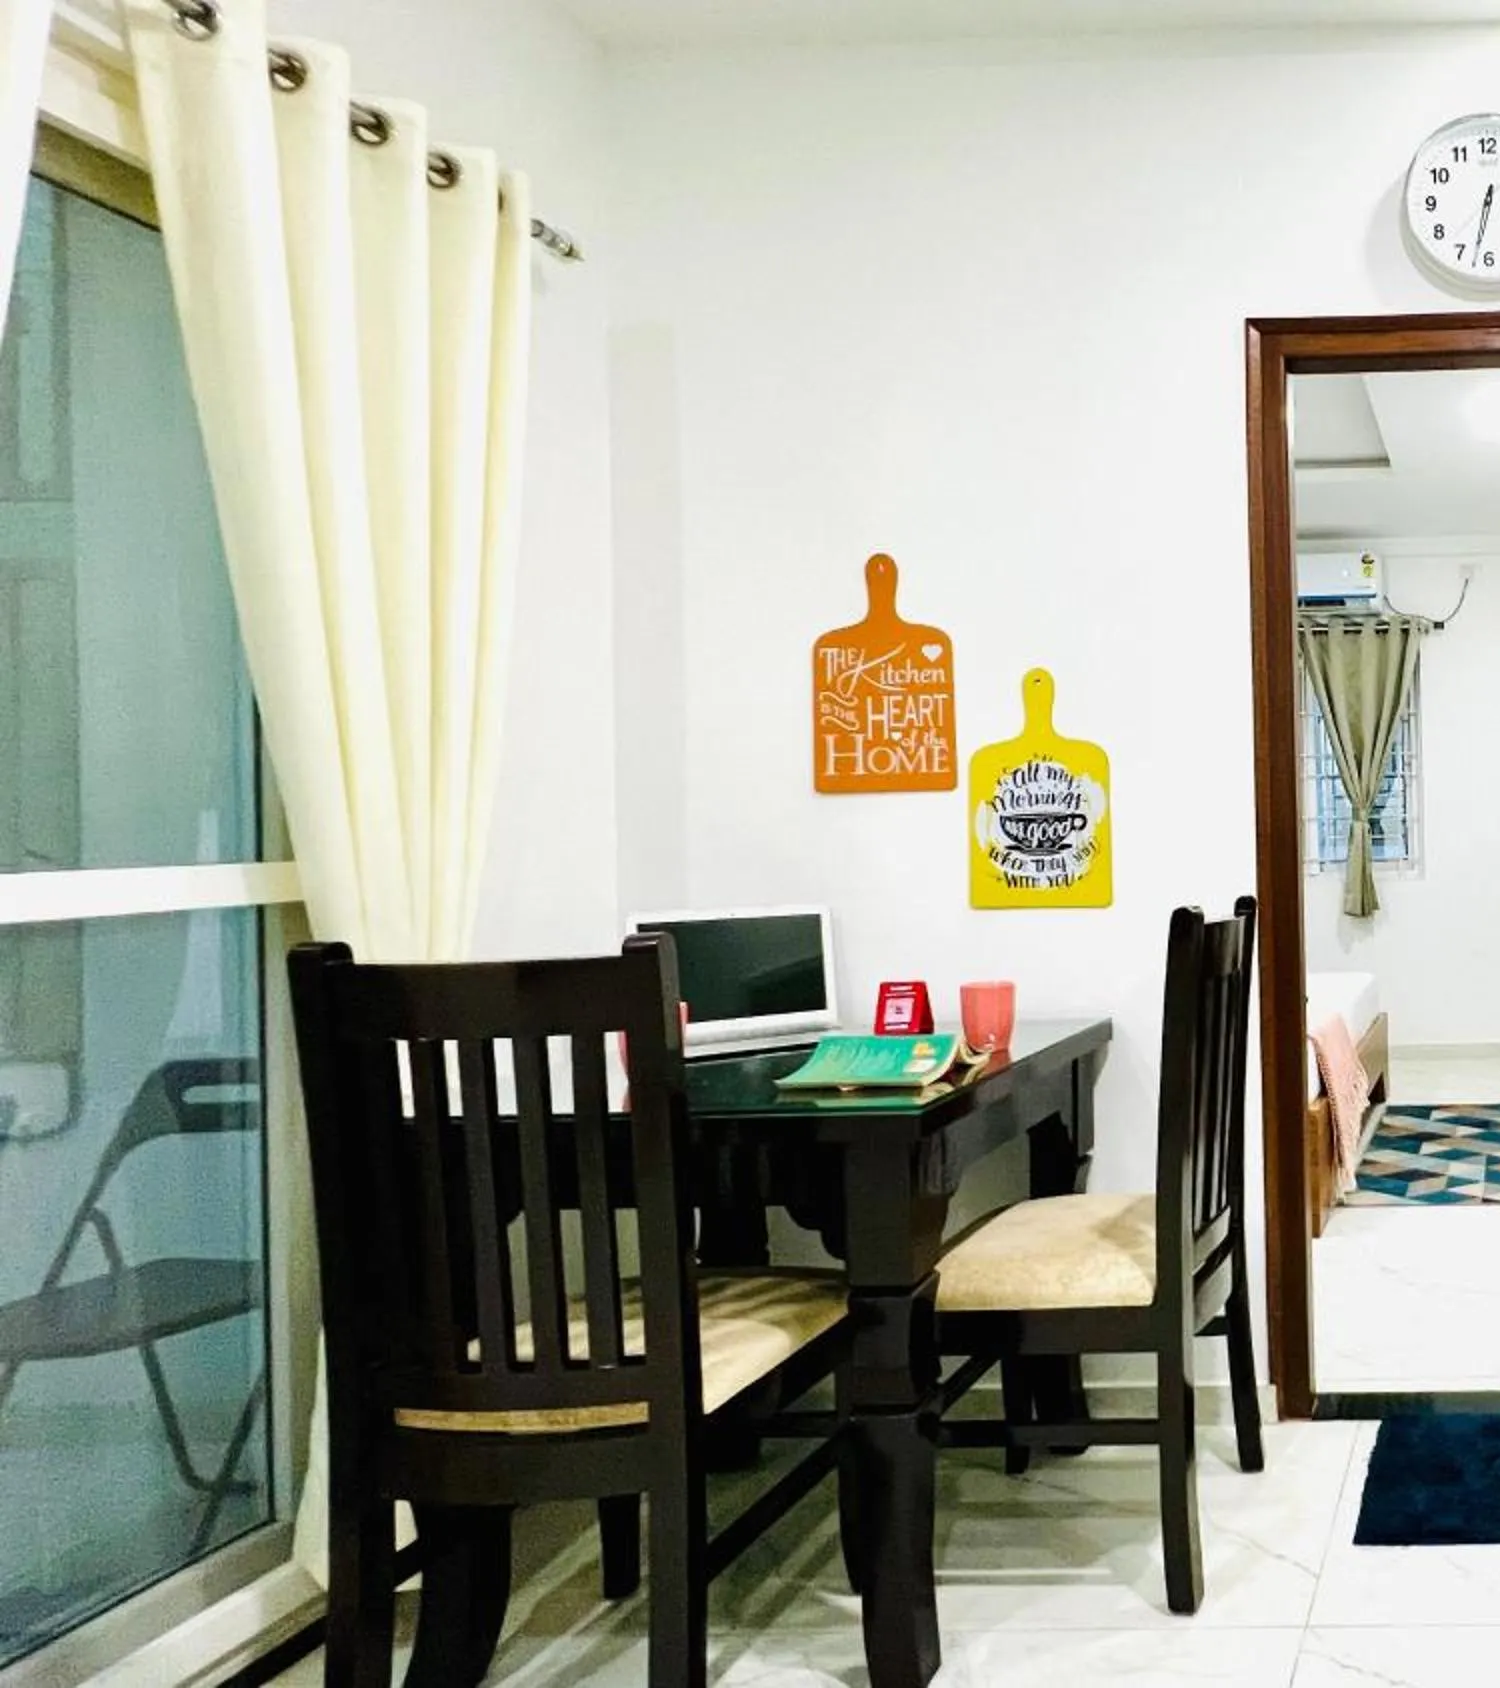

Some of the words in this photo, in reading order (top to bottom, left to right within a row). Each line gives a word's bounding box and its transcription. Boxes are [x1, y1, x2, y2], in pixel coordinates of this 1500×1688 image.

[1452, 146, 1467, 162] 11
[1478, 137, 1497, 155] 12
[1430, 168, 1450, 184] 10
[1425, 196, 1437, 212] 9
[1433, 224, 1445, 240] 8
[1454, 243, 1466, 261] 7
[1483, 251, 1495, 267] 6
[819, 647, 858, 685] THE
[836, 642, 946, 698] Kitchen
[866, 694, 949, 740] HEART
[822, 733, 951, 776] HOME
[1027, 816, 1071, 850] good
